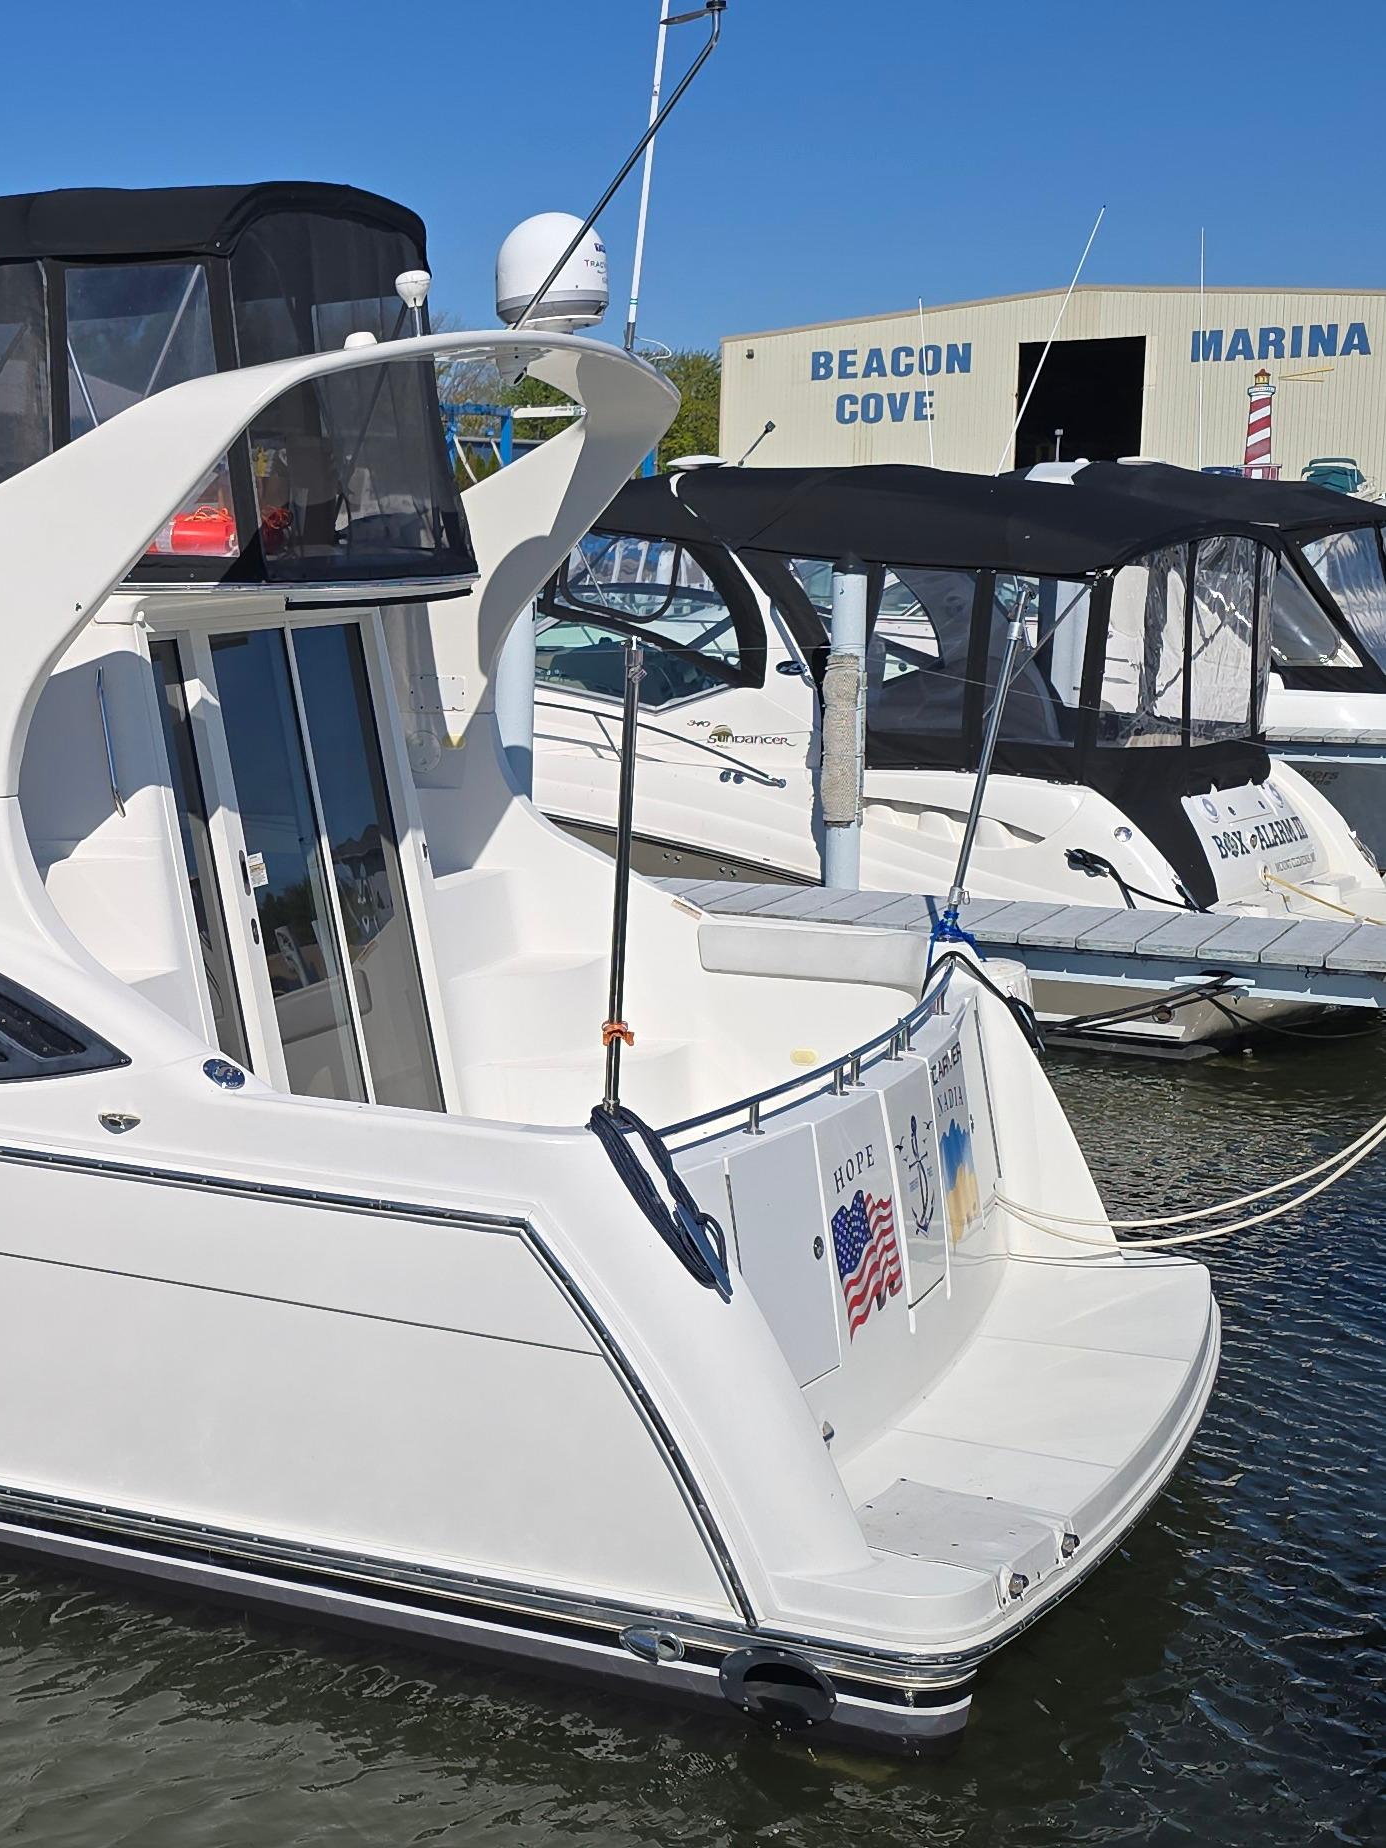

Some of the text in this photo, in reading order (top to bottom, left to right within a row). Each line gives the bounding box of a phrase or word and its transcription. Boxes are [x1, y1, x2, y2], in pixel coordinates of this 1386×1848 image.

[1190, 322, 1372, 363] MARINA
[810, 342, 972, 381] BEACON
[835, 390, 935, 425] COVE
[687, 719, 710, 728] 340
[1254, 818, 1298, 850] ALARM
[937, 1085, 964, 1117] NADIA
[833, 1144, 876, 1195] HOPE
